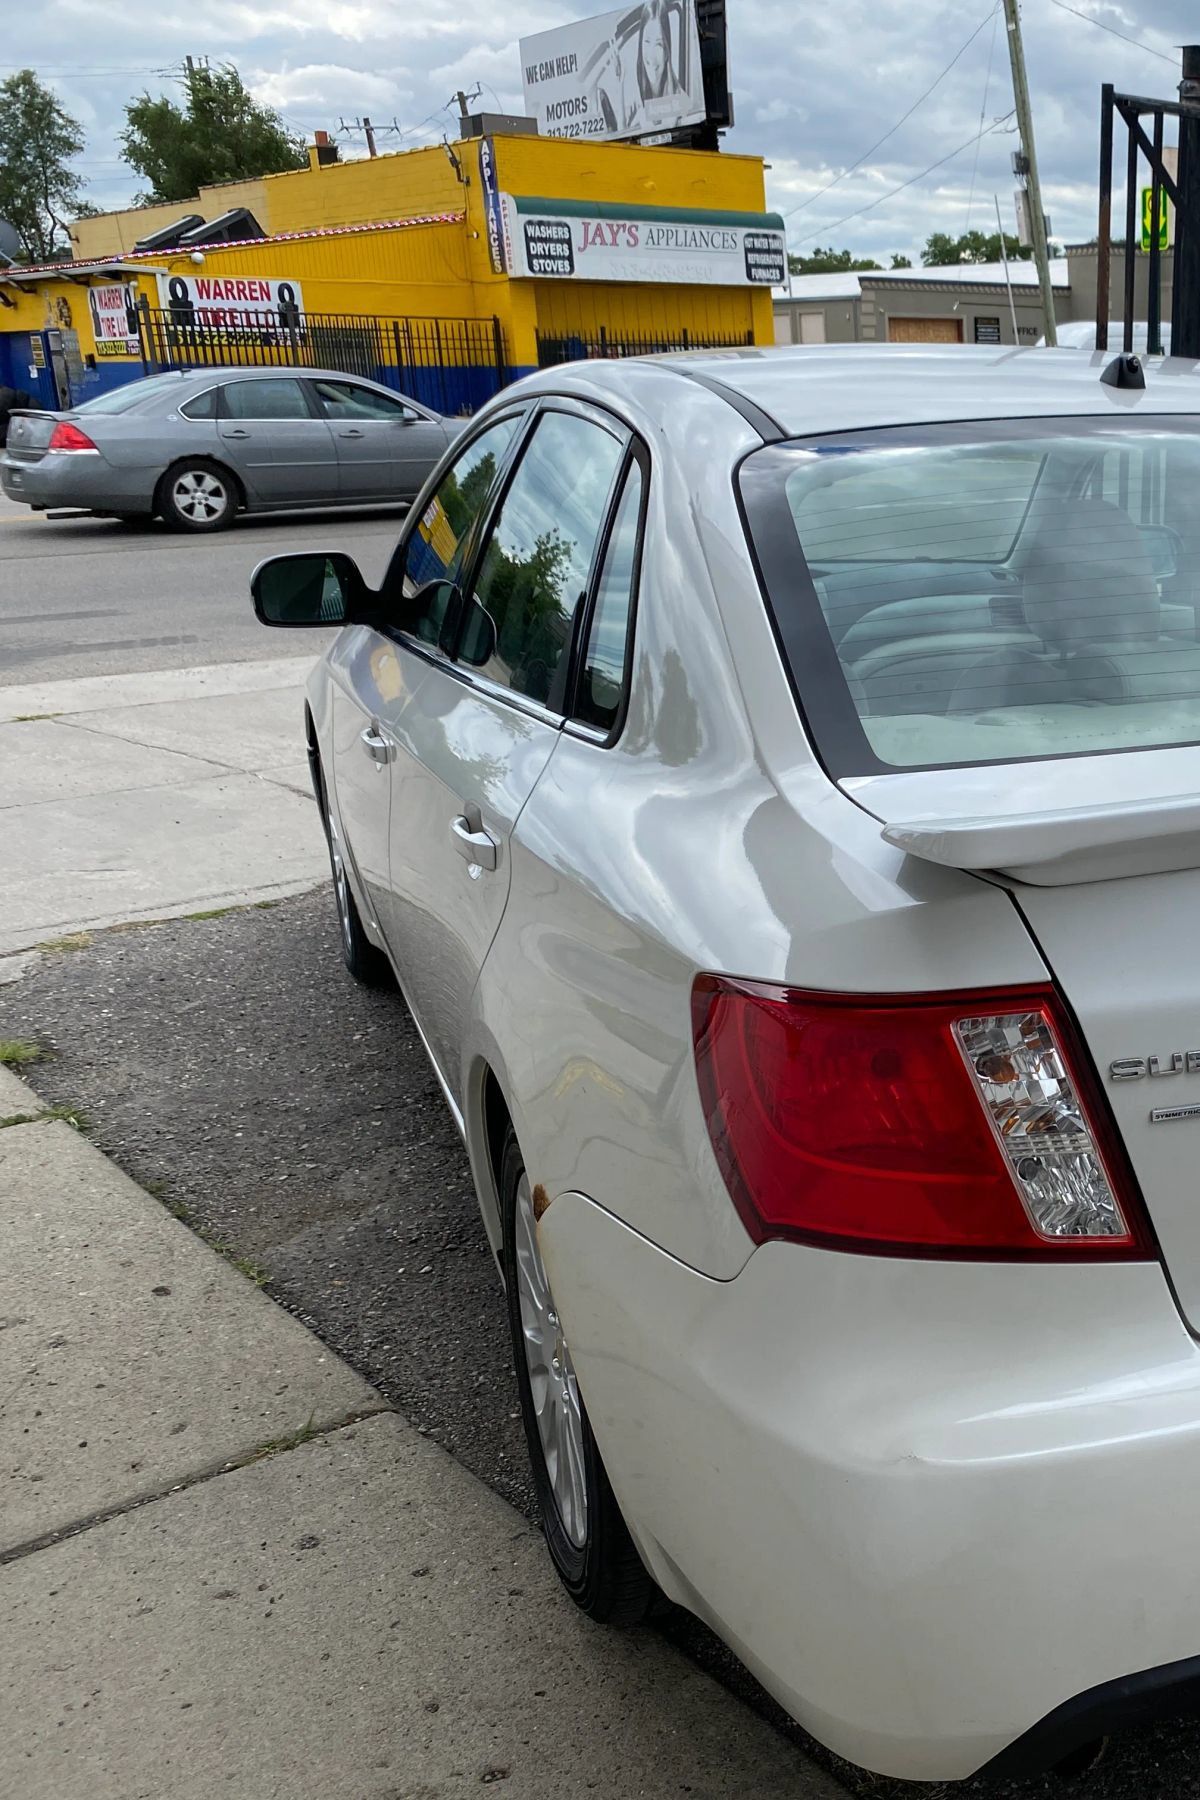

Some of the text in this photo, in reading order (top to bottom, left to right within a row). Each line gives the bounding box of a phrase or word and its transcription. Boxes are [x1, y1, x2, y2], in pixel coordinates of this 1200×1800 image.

[526, 53, 578, 85] WE CAN HELP!
[546, 96, 588, 122] MOTORS
[481, 140, 502, 273] APPLIANCES
[501, 199, 513, 270] APPLIANCES
[526, 224, 570, 240] WASHERS
[578, 222, 738, 253] JAY'S APPLIANCES
[530, 243, 570, 256] DRYERS
[533, 259, 571, 273] STOVES
[751, 268, 780, 280] FURNACES
[97, 288, 123, 310] WARREN
[195, 278, 271, 302] WARREN
[100, 317, 116, 337] TIRE
[198, 307, 239, 327] TIRE
